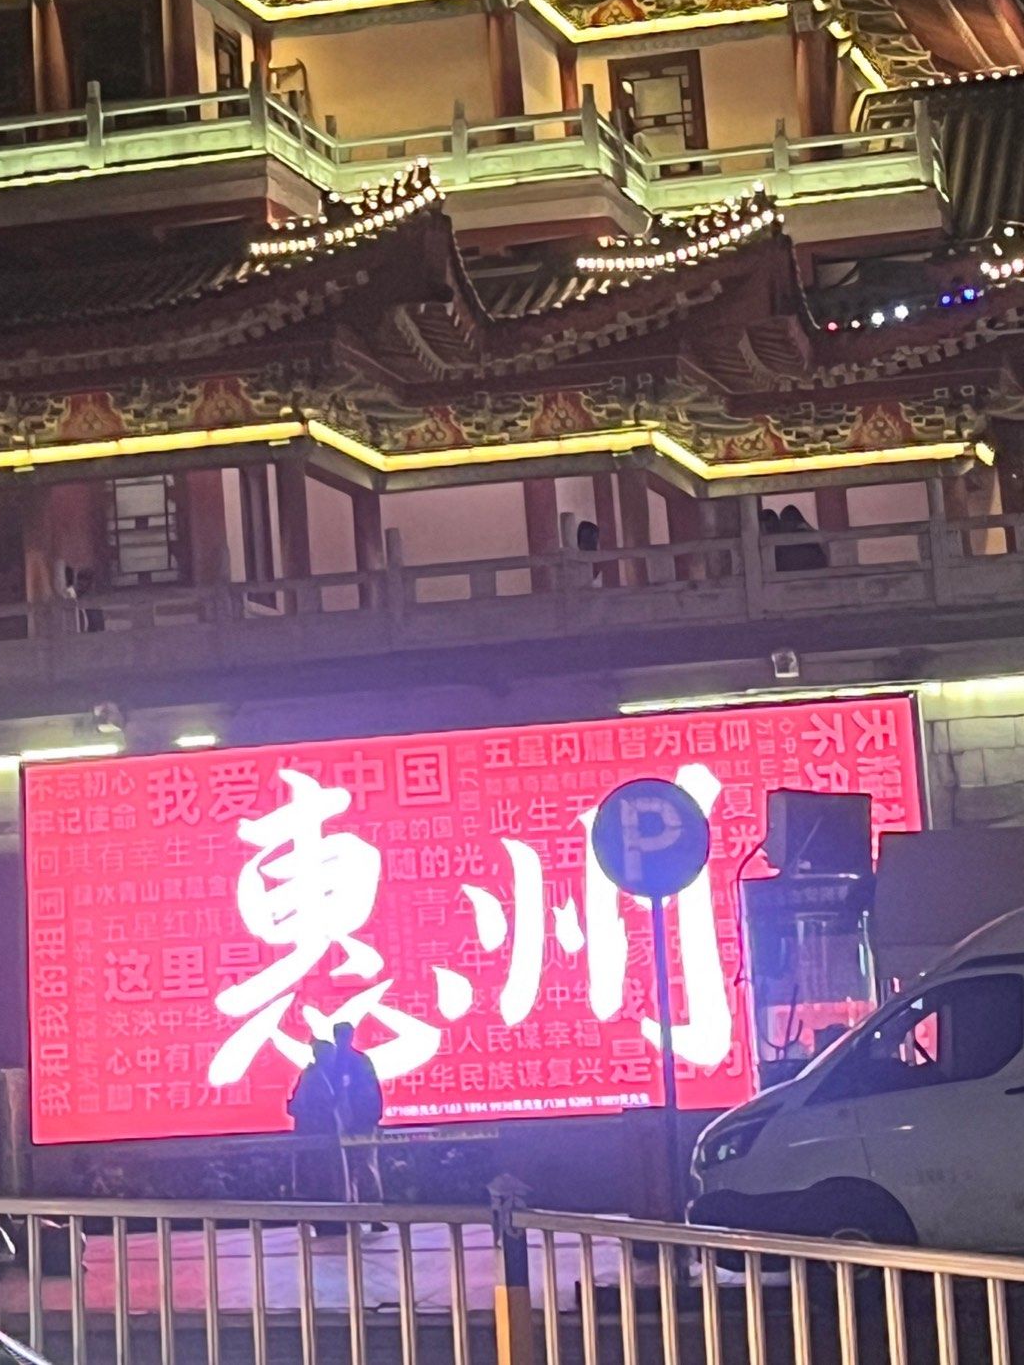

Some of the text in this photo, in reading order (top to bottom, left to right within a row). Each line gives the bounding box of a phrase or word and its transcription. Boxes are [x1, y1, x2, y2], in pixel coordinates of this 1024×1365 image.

[29, 769, 136, 802] 不忘初心
[621, 796, 682, 881] P
[33, 887, 72, 1116] 我和我的祖国
